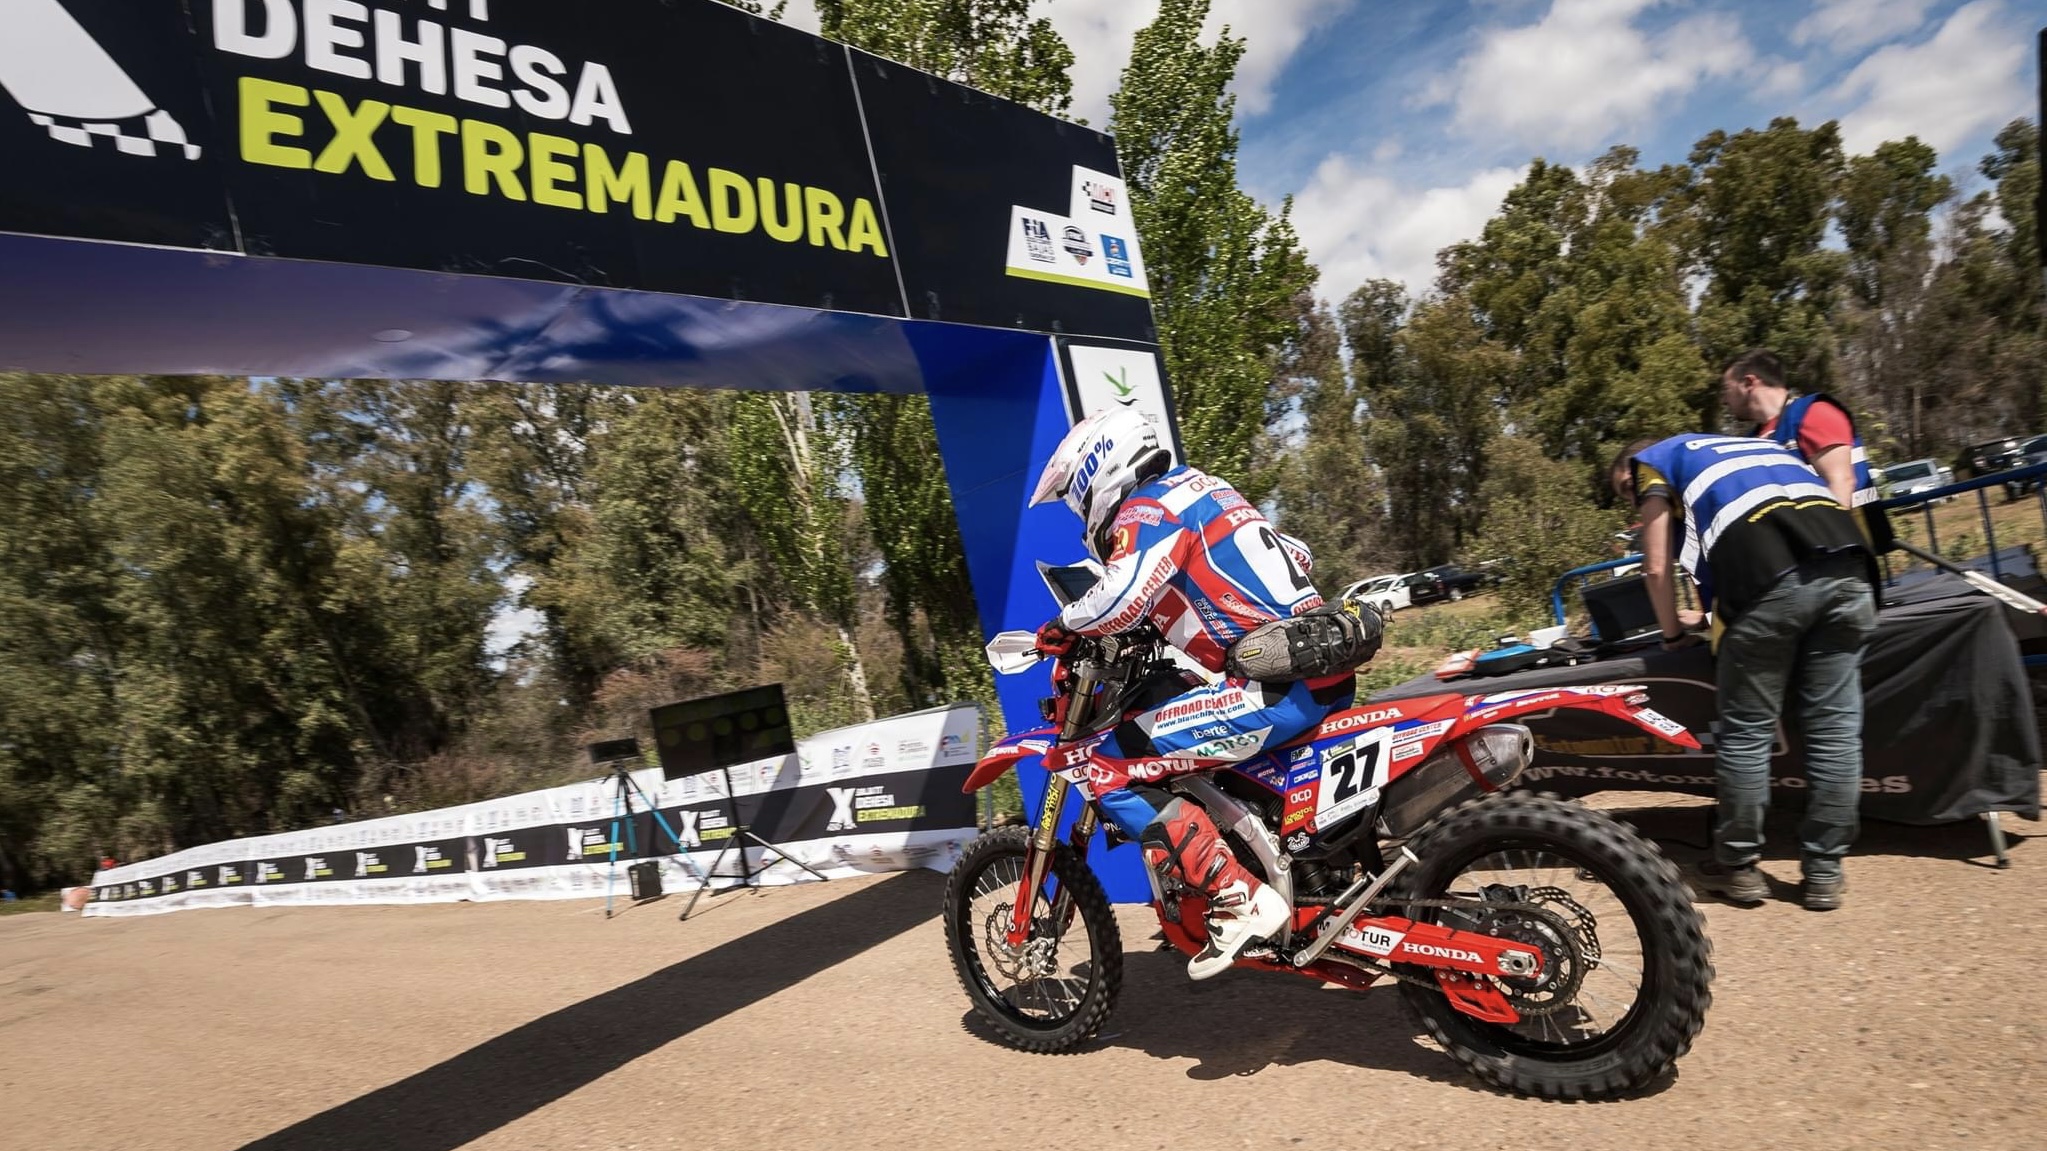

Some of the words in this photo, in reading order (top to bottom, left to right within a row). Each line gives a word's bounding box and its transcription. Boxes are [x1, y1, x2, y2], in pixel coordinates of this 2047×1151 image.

[212, 0, 633, 134] DEHESA
[238, 76, 890, 258] EXTREMADURA
[1069, 434, 1114, 503] 100%
[1098, 596, 1146, 634] OFFROAD
[1141, 556, 1173, 599] CENTER
[1155, 699, 1203, 723] OFFROAD
[1320, 707, 1404, 734] HONDA
[1128, 758, 1200, 780] MOTUL
[1330, 740, 1380, 805] 27
[1403, 941, 1486, 964] HONDA
